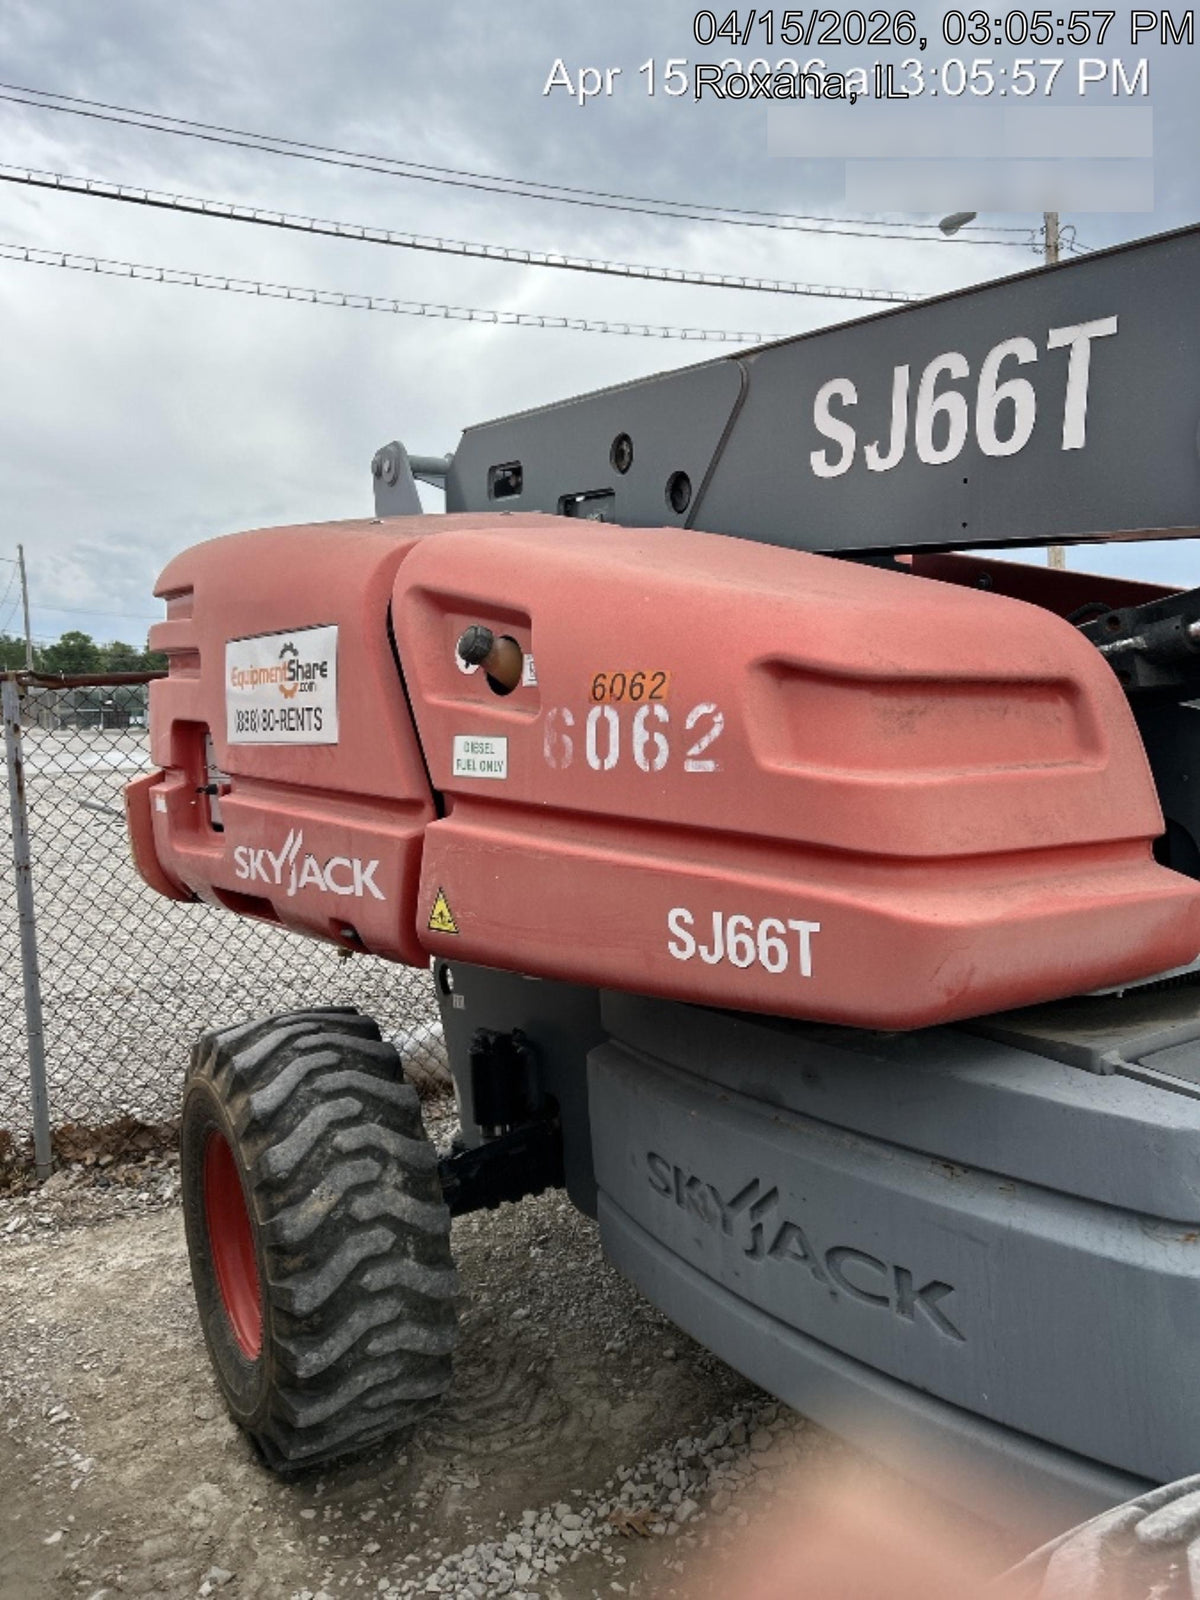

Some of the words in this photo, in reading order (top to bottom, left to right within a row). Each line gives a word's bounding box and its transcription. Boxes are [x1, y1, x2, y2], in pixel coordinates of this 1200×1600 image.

[810, 314, 1118, 478] SJ66T
[230, 659, 328, 690] EquipmentShare
[592, 671, 667, 701] 6062
[456, 758, 476, 771] FUEL
[479, 760, 504, 773] ONLY
[463, 741, 496, 755] DIESEL
[543, 702, 725, 773] 6062
[233, 828, 386, 900] SKYJACK
[667, 907, 821, 978] SJ66T
[647, 1151, 966, 1343] SKYJACK
